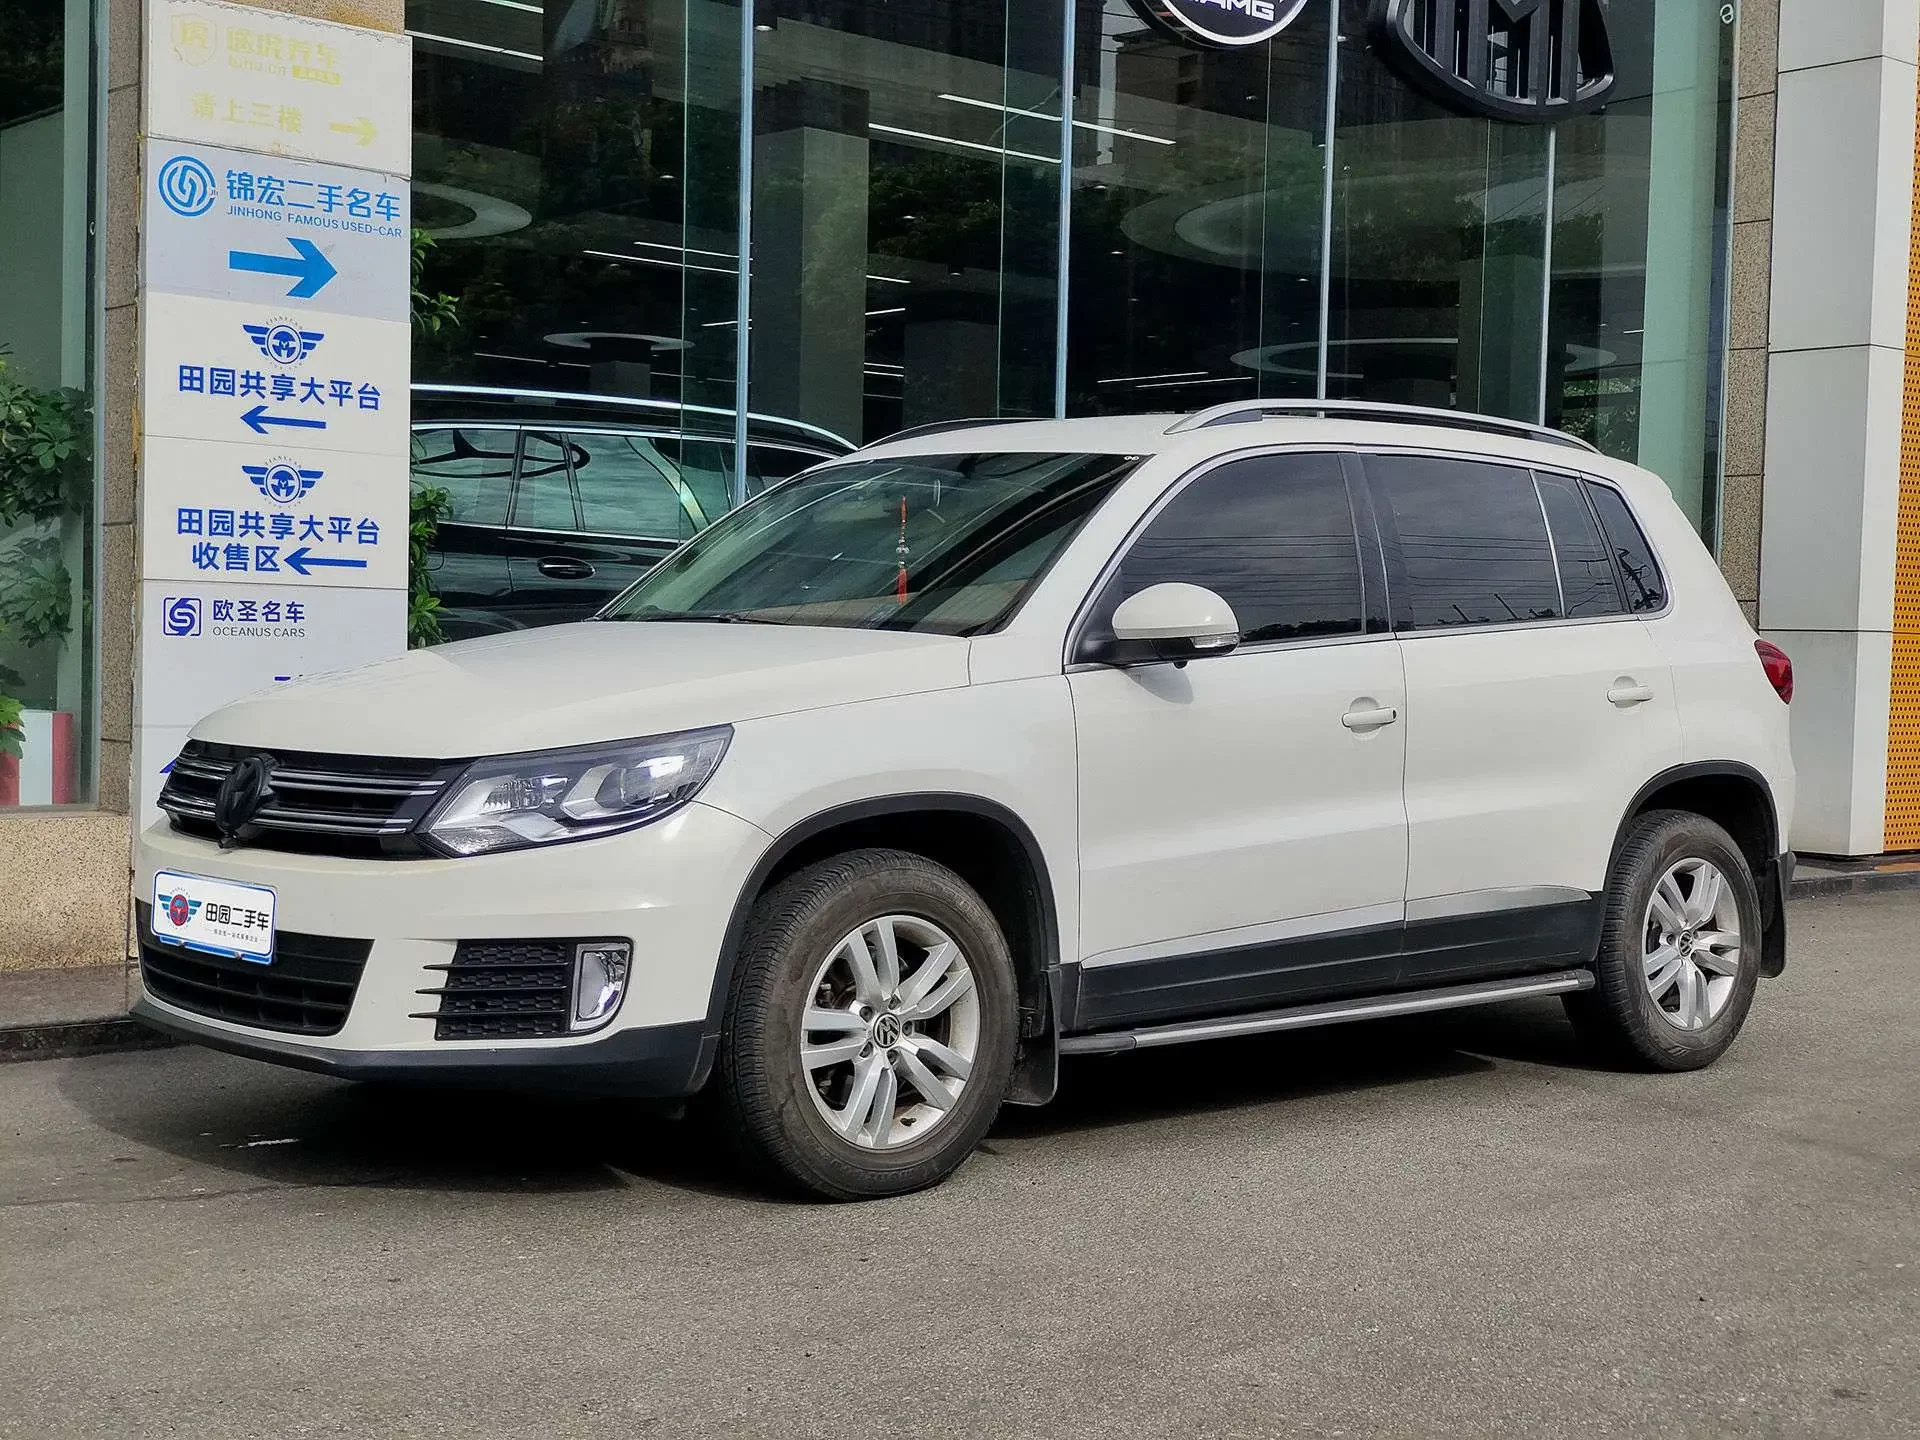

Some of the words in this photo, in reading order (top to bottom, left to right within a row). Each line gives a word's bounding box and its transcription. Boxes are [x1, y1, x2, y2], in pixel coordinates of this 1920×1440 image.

[191, 91, 302, 134] 请上三楼
[226, 169, 401, 222] 锦宏二手名车
[227, 205, 282, 221] JINHONG
[288, 213, 339, 230] FAMOUS
[341, 221, 402, 238] USED-CAR
[178, 364, 381, 411] 田园共享大平台
[177, 508, 380, 545] 田园共享大平台
[192, 541, 280, 572] 收售区
[213, 600, 305, 623] 欧圣名车
[212, 626, 271, 637] OCEANUS
[273, 628, 306, 637] CARS
[206, 903, 270, 931] 田园二手车
